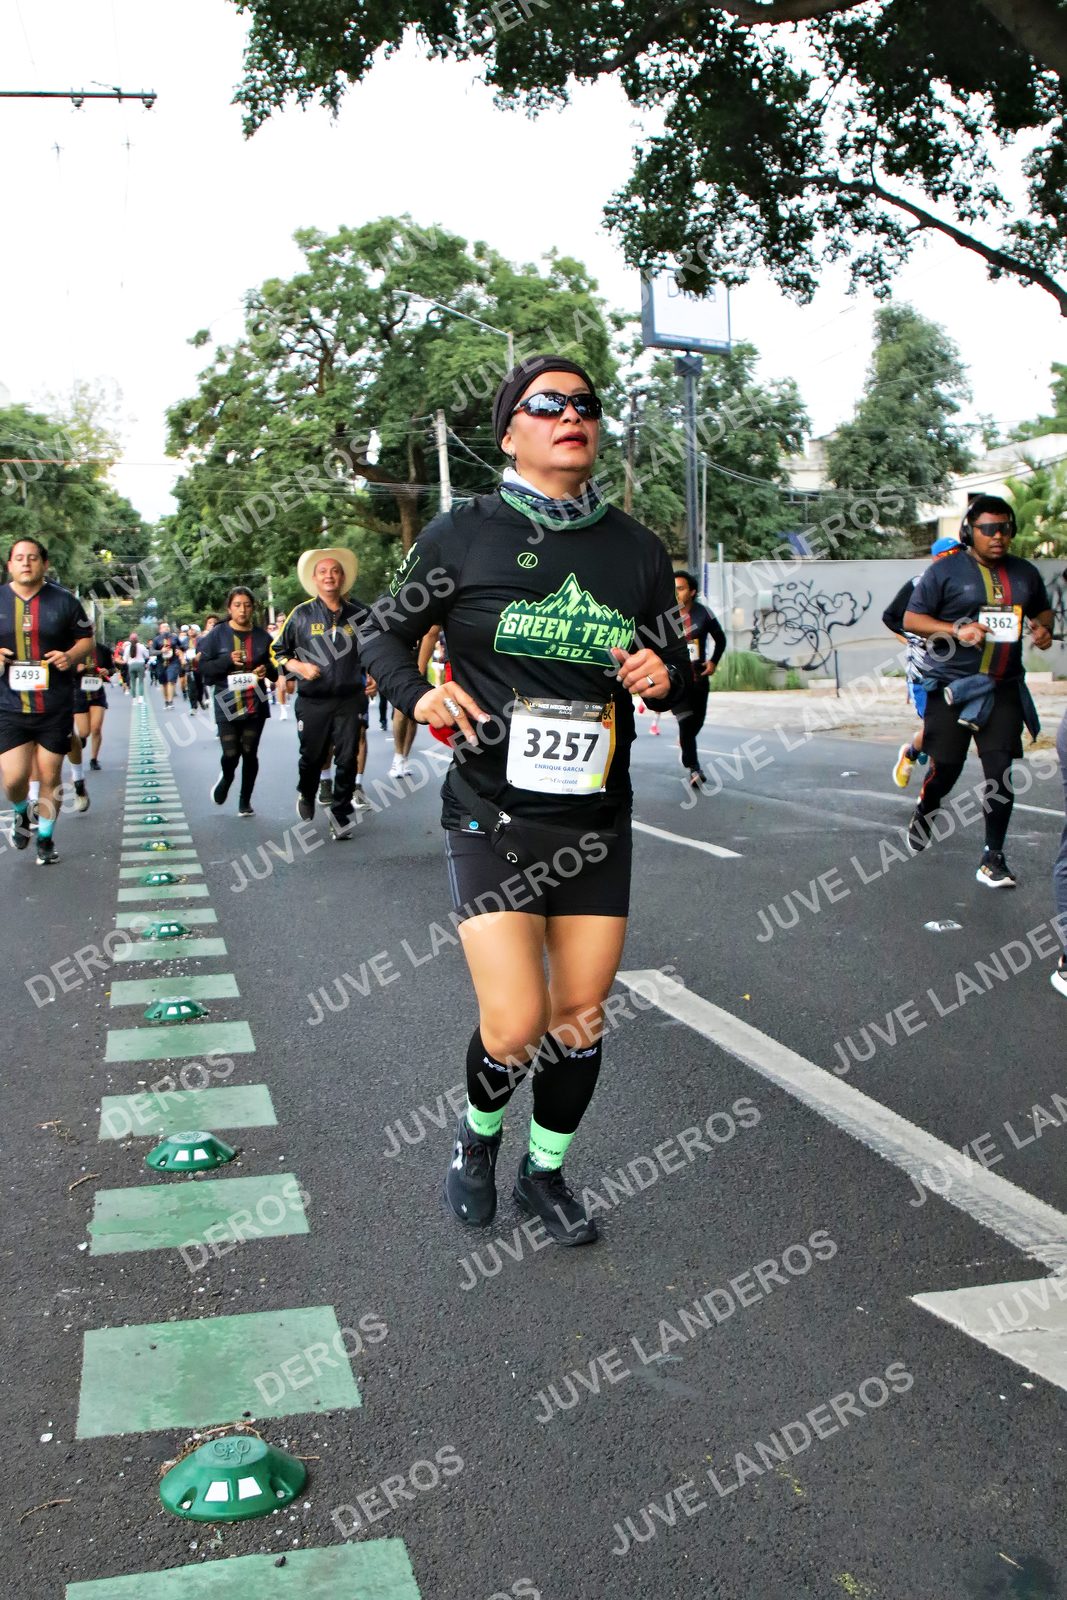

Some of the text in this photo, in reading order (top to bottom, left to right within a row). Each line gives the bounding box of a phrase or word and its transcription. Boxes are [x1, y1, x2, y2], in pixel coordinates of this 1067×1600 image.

[773, 579, 814, 595] TOY
[556, 646, 604, 659] GDL
[15, 670, 40, 680] 3493
[523, 728, 599, 762] 3257
[534, 763, 561, 771] ENRIQUE
